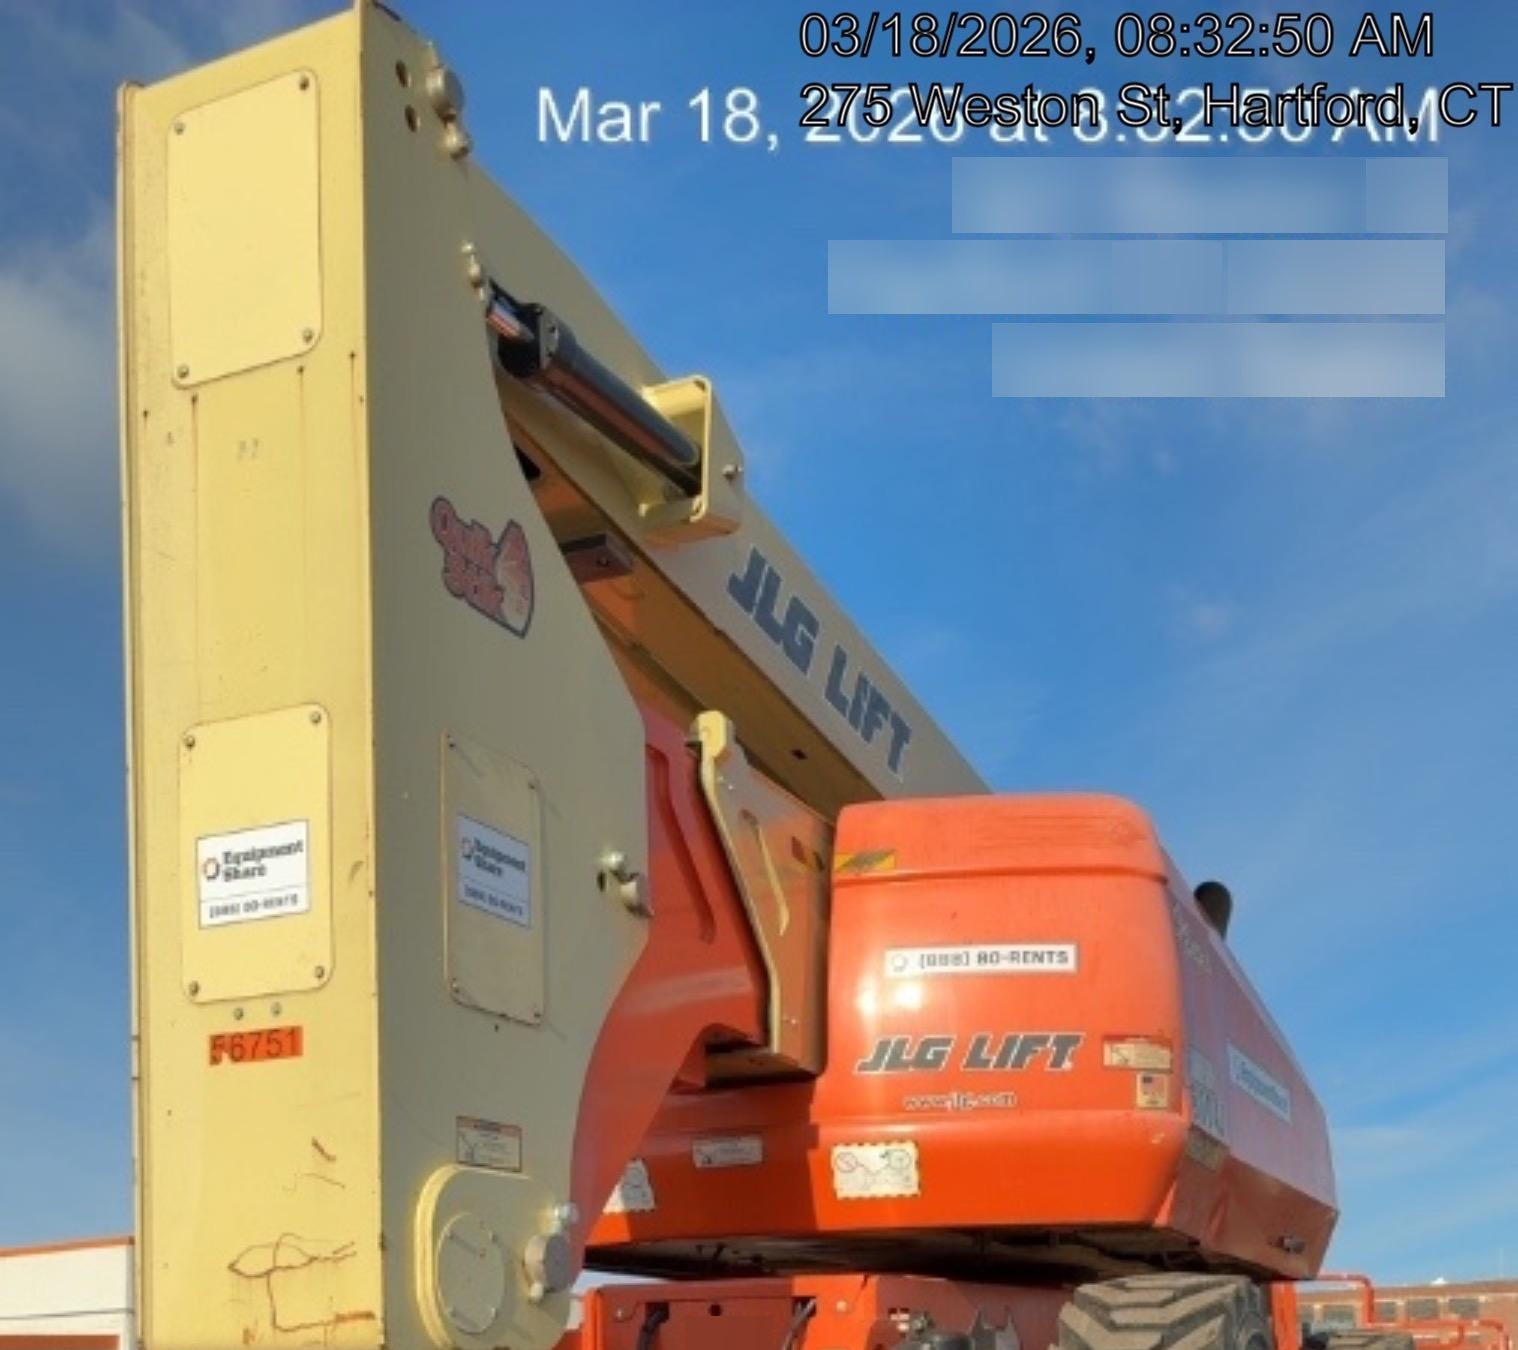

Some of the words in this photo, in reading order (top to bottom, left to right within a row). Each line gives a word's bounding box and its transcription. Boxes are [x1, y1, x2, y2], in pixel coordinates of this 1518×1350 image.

[727, 547, 820, 676] JLG
[824, 643, 912, 774] LIFT
[855, 1034, 957, 1074] JLG
[960, 1032, 1087, 1071] LIFT
